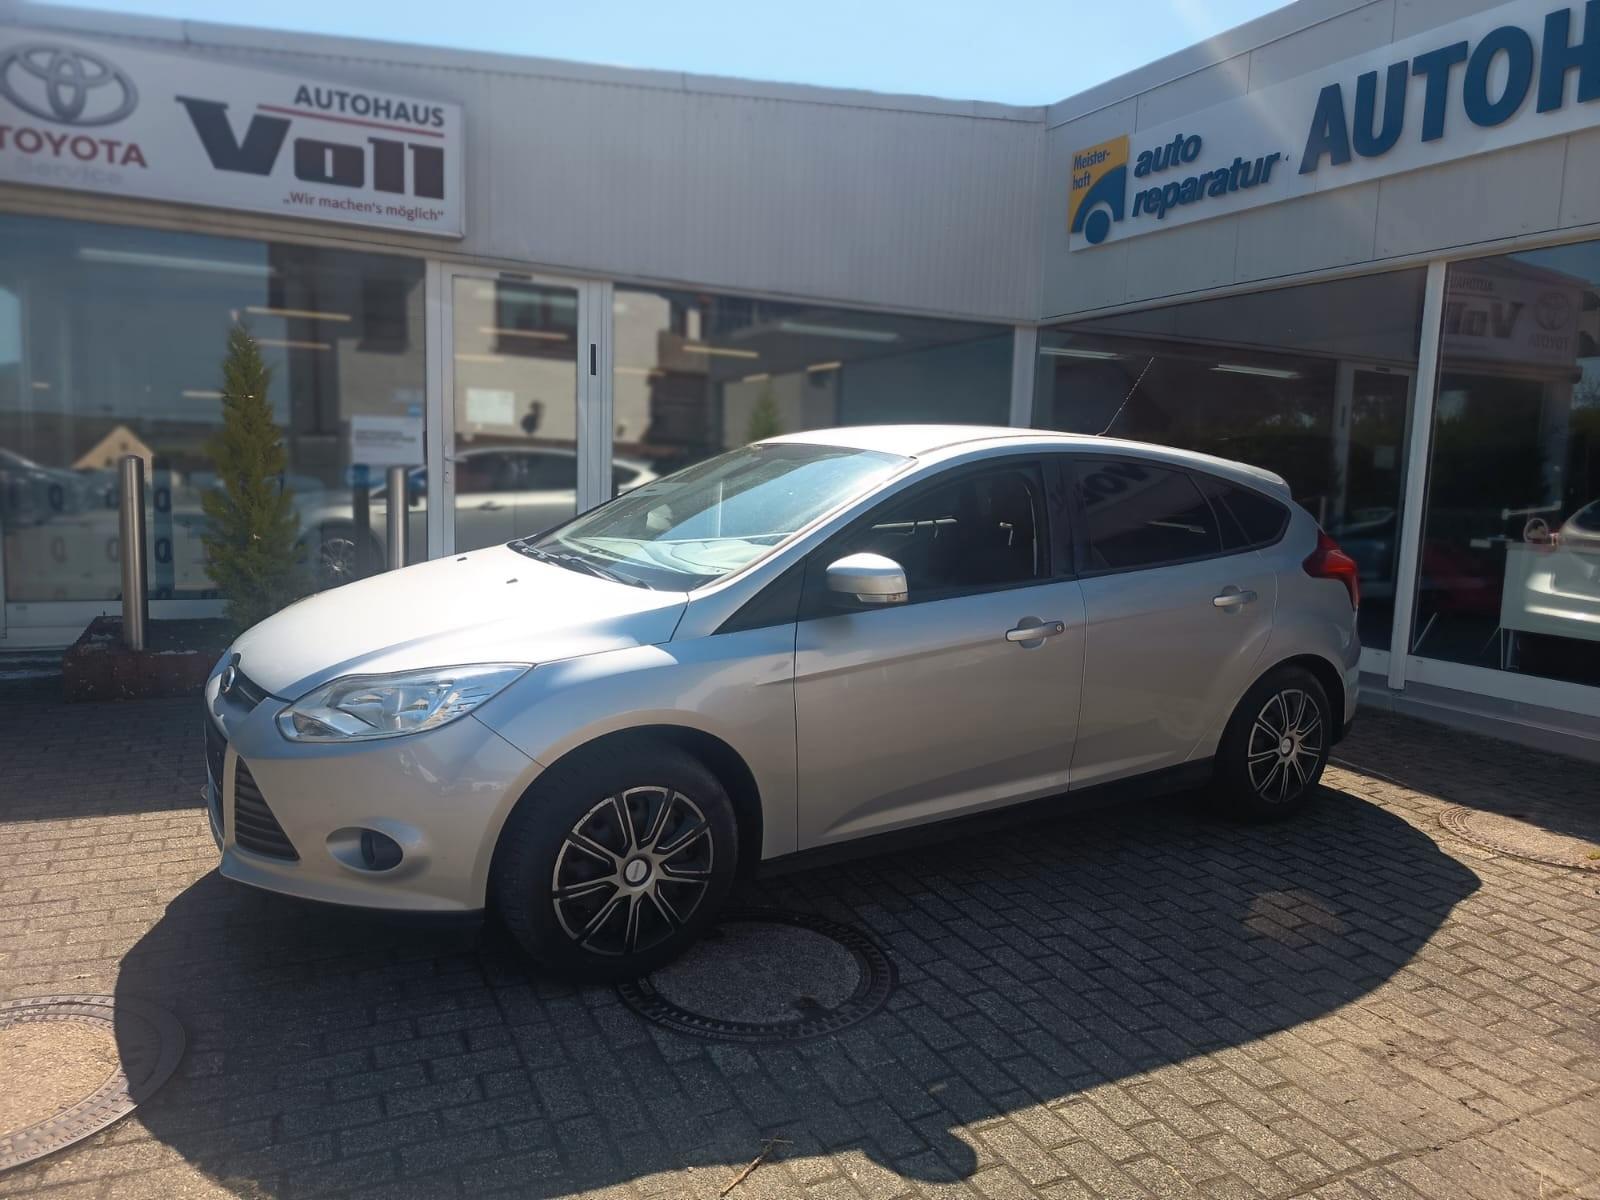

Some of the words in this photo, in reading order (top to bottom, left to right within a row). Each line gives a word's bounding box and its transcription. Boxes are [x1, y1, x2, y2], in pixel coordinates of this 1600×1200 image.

[293, 84, 445, 128] AUTOHAUS
[1298, 0, 1600, 174] AUTOH
[174, 94, 445, 200] Voll
[1073, 150, 1111, 171] Meister-
[1134, 133, 1202, 178] auto
[1072, 172, 1091, 191] haft
[1132, 152, 1281, 219] reparatur
[318, 197, 382, 214] machen's
